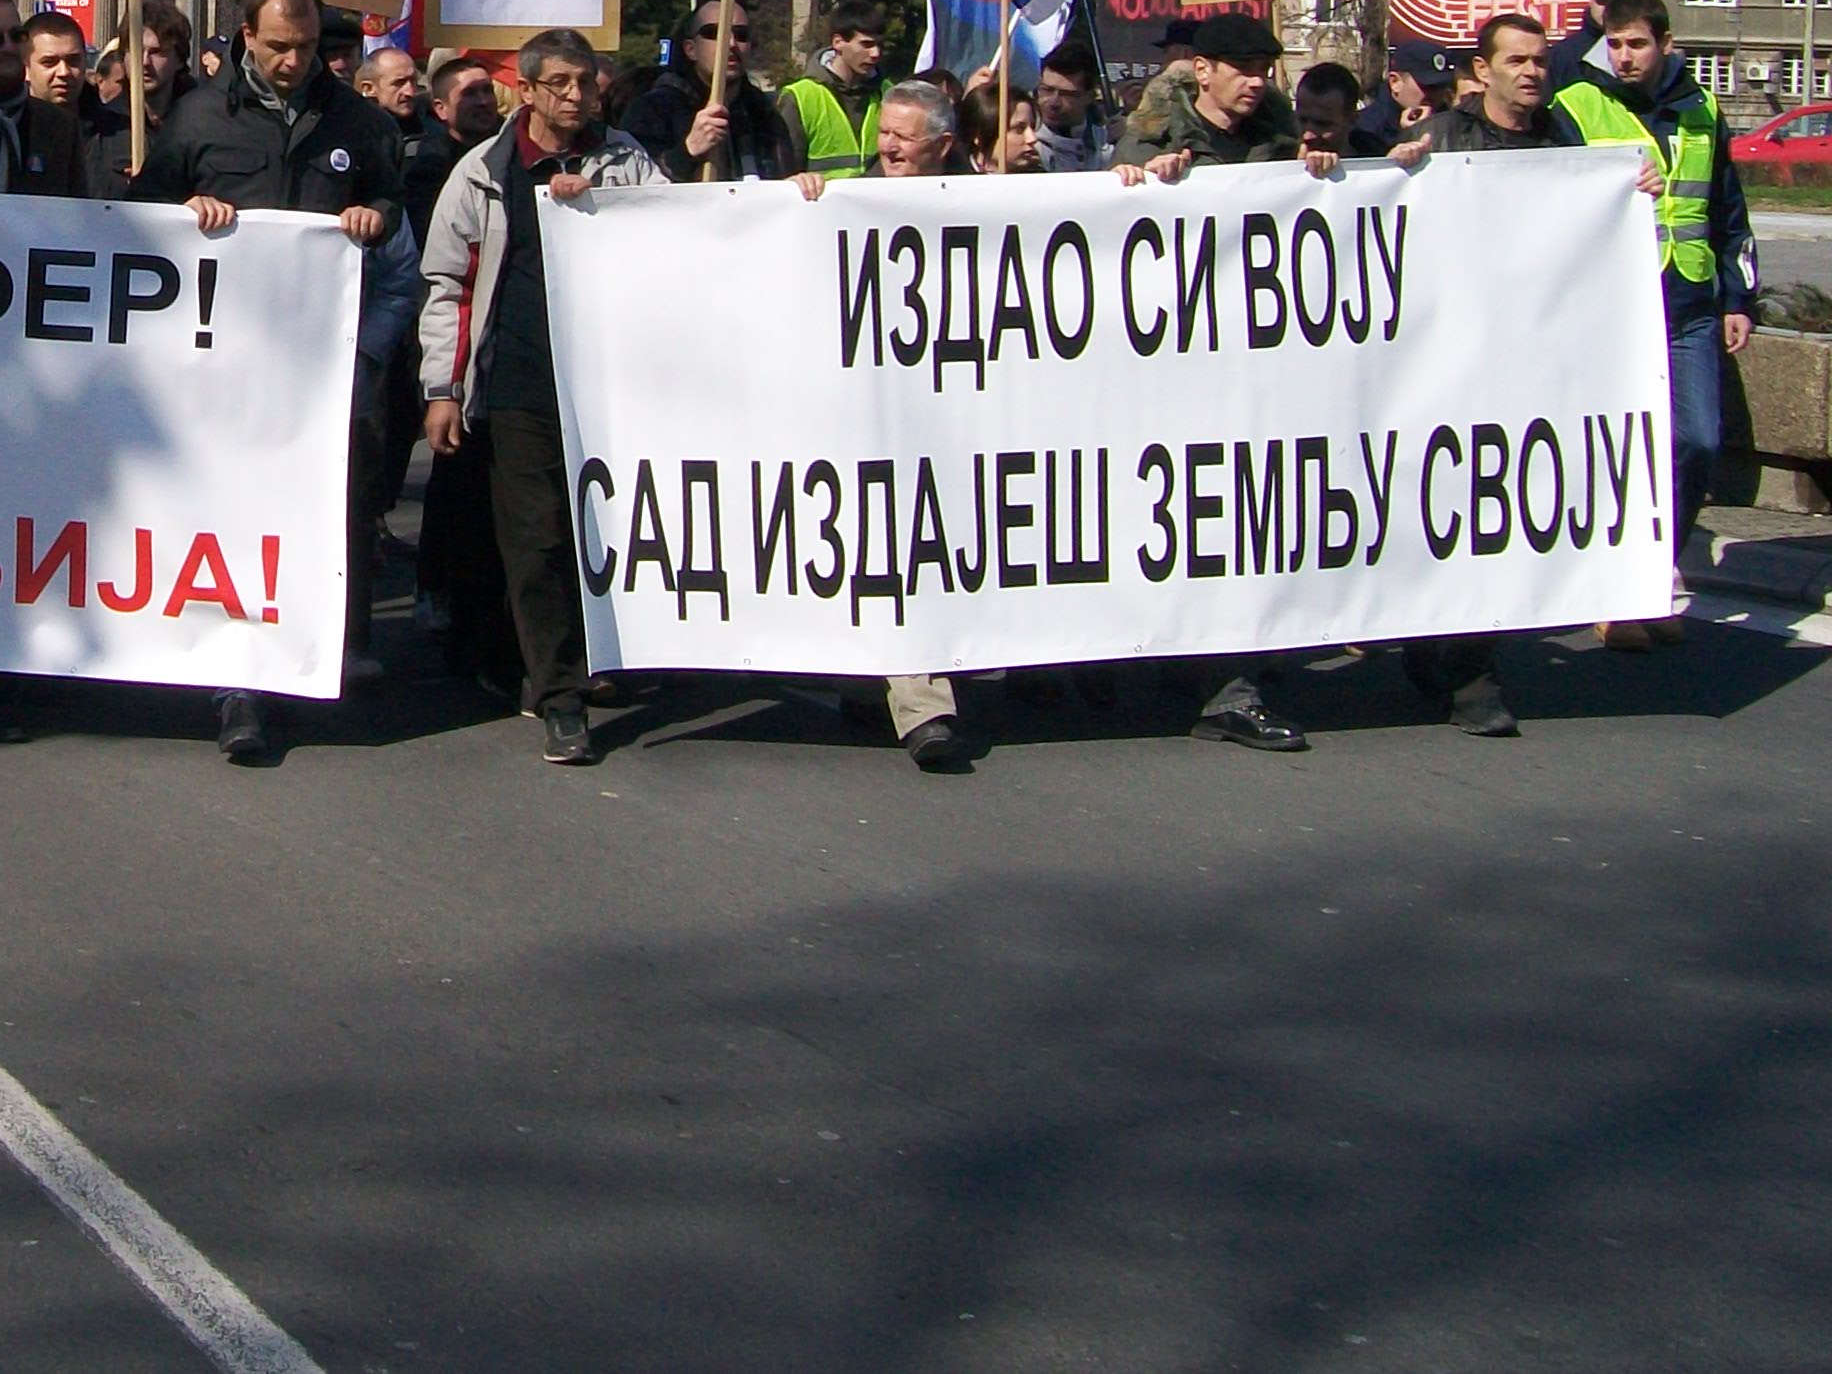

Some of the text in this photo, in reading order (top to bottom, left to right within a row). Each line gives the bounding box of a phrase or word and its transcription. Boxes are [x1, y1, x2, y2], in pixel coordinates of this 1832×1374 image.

[837, 204, 1408, 393] ИЗДАО СИ ВОЈУ
[576, 410, 1663, 627] САД ИЗДАЈЕШ ЗЕМЉУ СВОЈУ!
